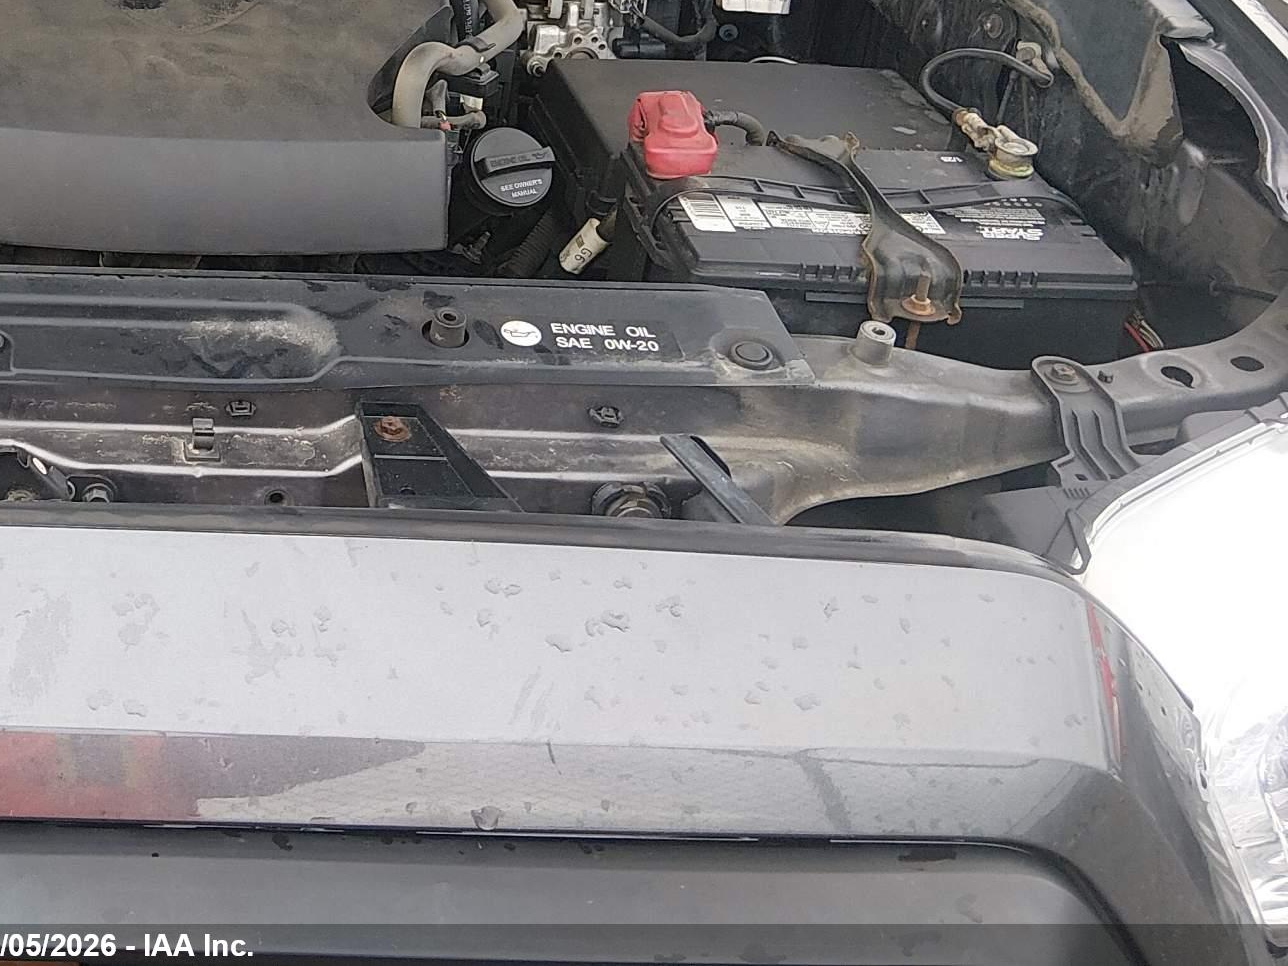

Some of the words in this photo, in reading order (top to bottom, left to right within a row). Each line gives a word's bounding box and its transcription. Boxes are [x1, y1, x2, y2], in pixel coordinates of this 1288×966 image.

[500, 184, 513, 192] SEE
[513, 179, 543, 189] OWNER'S
[511, 188, 538, 198] MANUAL
[575, 248, 592, 263] G6
[550, 322, 616, 337] ENGINE
[625, 326, 656, 338] OIL
[555, 337, 593, 349] SAE
[604, 338, 659, 352] 0W-20
